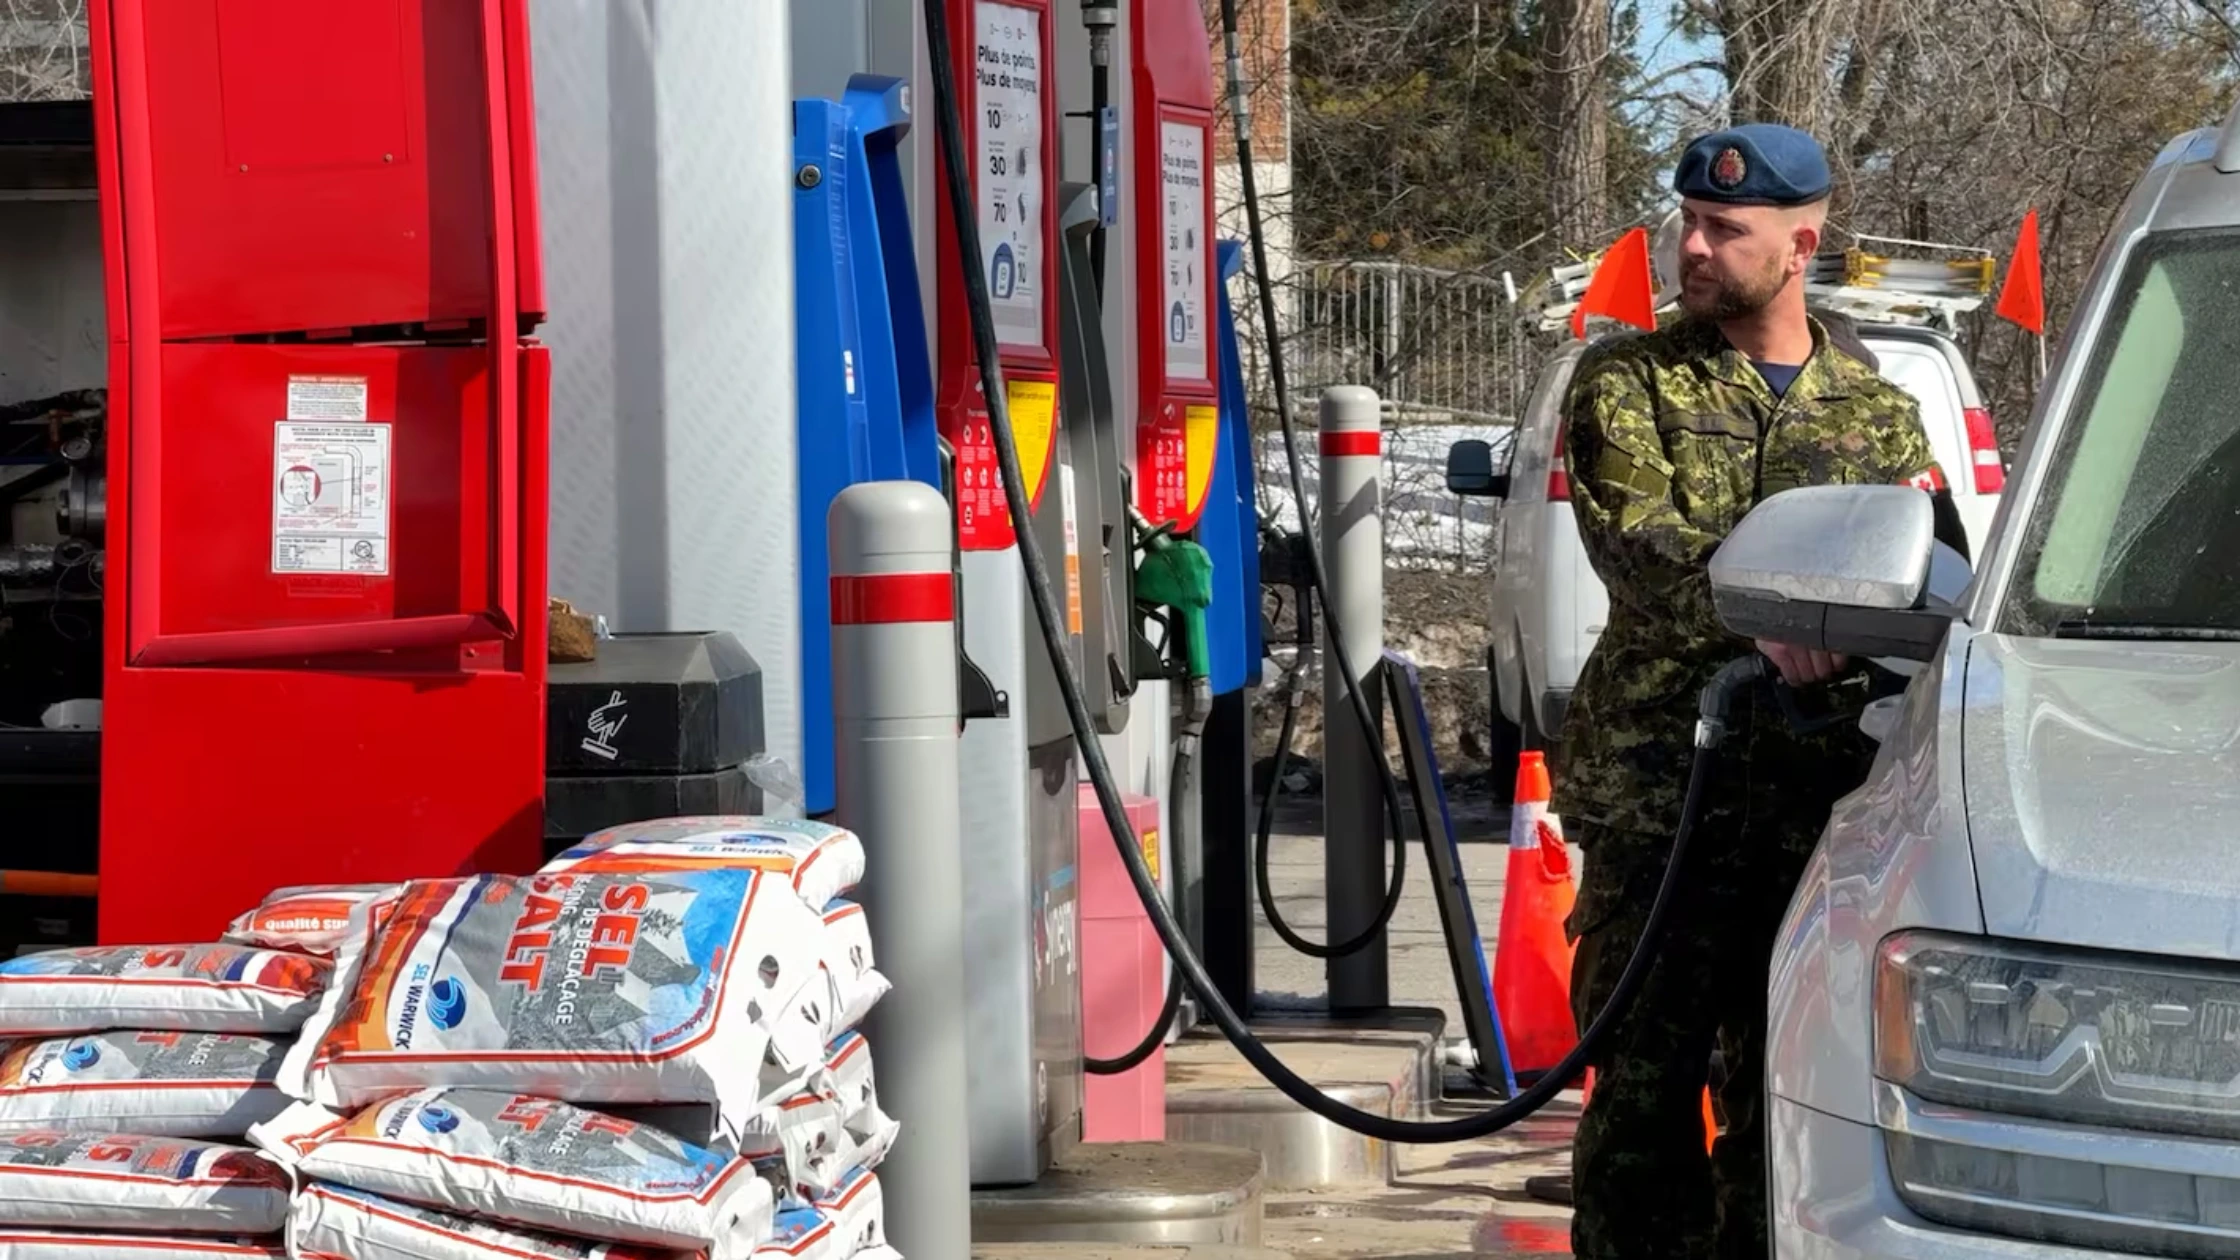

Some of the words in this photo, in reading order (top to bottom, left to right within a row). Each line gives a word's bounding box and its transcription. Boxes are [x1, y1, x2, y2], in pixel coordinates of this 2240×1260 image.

[978, 45, 999, 63] Plus
[1001, 48, 1011, 65] de
[976, 68, 996, 87] Plus
[999, 70, 1011, 88] de
[987, 109, 1001, 129] 10
[989, 155, 1006, 176] 30
[993, 202, 1006, 223] 70
[583, 884, 650, 977] SEL
[412, 963, 430, 982] SEL
[395, 985, 424, 1050] WARWICK
